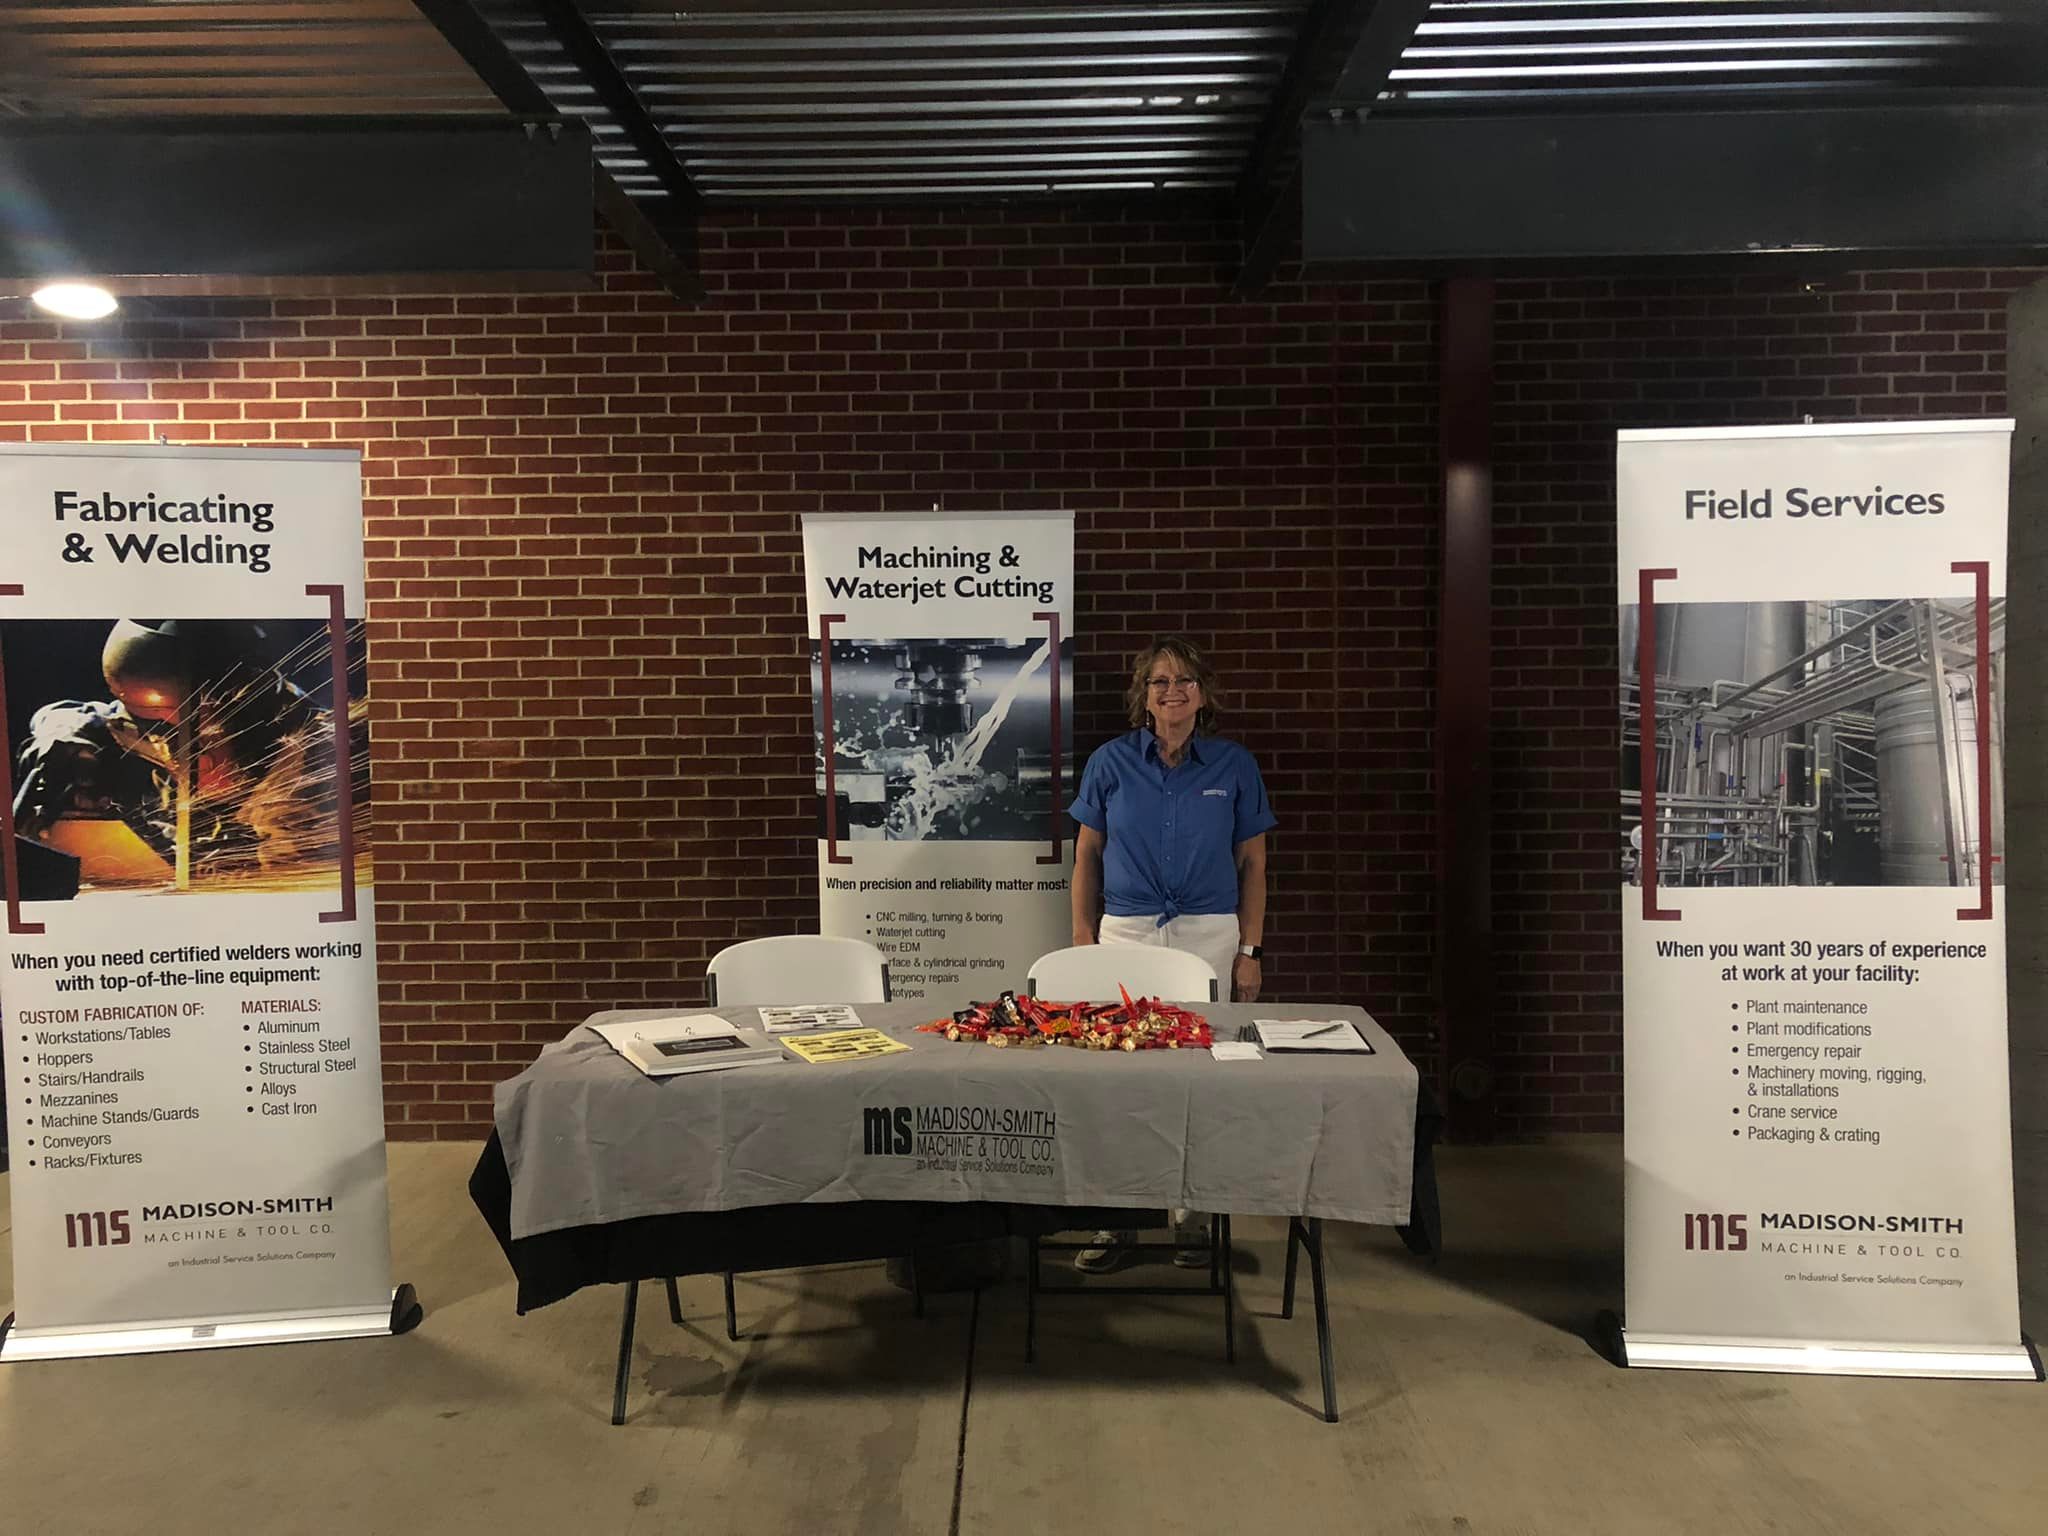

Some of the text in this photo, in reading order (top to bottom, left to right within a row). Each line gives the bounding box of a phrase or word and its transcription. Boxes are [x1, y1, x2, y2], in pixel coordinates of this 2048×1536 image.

[1686, 485, 1945, 520] Field Services
[55, 491, 274, 532] Fabricating
[62, 533, 270, 573] & Welding
[858, 545, 1020, 574] Machining &
[825, 576, 1054, 604] Waterjet Cutting
[826, 878, 1068, 892] When precision and reliability matter most:
[876, 912, 1002, 924] CNC milling, turning & boring
[877, 927, 945, 939] Waterjet cutting
[877, 942, 920, 952] Wire EDM
[1657, 941, 1986, 961] When you want 30 years of experience
[12, 942, 361, 970] When you need certified welders working
[889, 958, 1004, 969] rface & cylindrical grinding
[56, 967, 320, 992] with top-of-the-line equipment:
[889, 973, 959, 986] ergency repairs
[1722, 965, 1919, 985] at work at your facility:
[20, 1003, 204, 1024] CUSTOM FABRICATION OF:
[242, 999, 321, 1013] MATERIALS:
[1747, 1000, 1867, 1014] Plant maintenance
[258, 1021, 319, 1033] Aluminum
[1747, 1022, 1871, 1036] Plant modifications
[36, 1026, 170, 1045] Workstations/Tables
[259, 1038, 350, 1054] Stainless Steel
[1747, 1044, 1862, 1061] Emergency repair
[38, 1053, 93, 1067] Hoppers
[260, 1058, 356, 1075] Structural Steel
[39, 1069, 144, 1087] Stairs/Handrails
[1747, 1065, 1926, 1084] Machinery moving, rigging,
[261, 1082, 296, 1097] Alloys
[1747, 1083, 1839, 1098] & installations
[40, 1092, 118, 1107] Mezzanines
[262, 1103, 317, 1115] Cast Iron
[1748, 1105, 1837, 1119] Crane service
[42, 1107, 199, 1128] Machine Stands/Guards
[917, 1107, 1055, 1136] MADISON-SMITH
[43, 1134, 111, 1149] Conveyors
[1748, 1126, 1880, 1145] Packaging & crating
[917, 1136, 973, 1157] MACHINE
[979, 1137, 986, 1157] &
[992, 1137, 1026, 1159] TOOL
[44, 1153, 142, 1169] Racks/Fixtures
[143, 1197, 332, 1221] MADISON-SMITH
[1761, 1213, 1963, 1234] MADISON-SMITH
[145, 1229, 227, 1243] MACHINE
[237, 1228, 246, 1237] &
[257, 1225, 299, 1236] TOOL
[1762, 1242, 1846, 1255] MACHINE
[1857, 1245, 1866, 1256] &
[1879, 1246, 1924, 1257] TOOL
[182, 1256, 220, 1266] Industrial
[223, 1255, 254, 1264] Service
[257, 1252, 293, 1262] Solutions
[296, 1250, 336, 1261] Company
[1799, 1272, 1838, 1282] Industrial
[1841, 1273, 1874, 1284] Service
[1877, 1275, 1916, 1285] Solutions
[1919, 1276, 1963, 1288] Company
